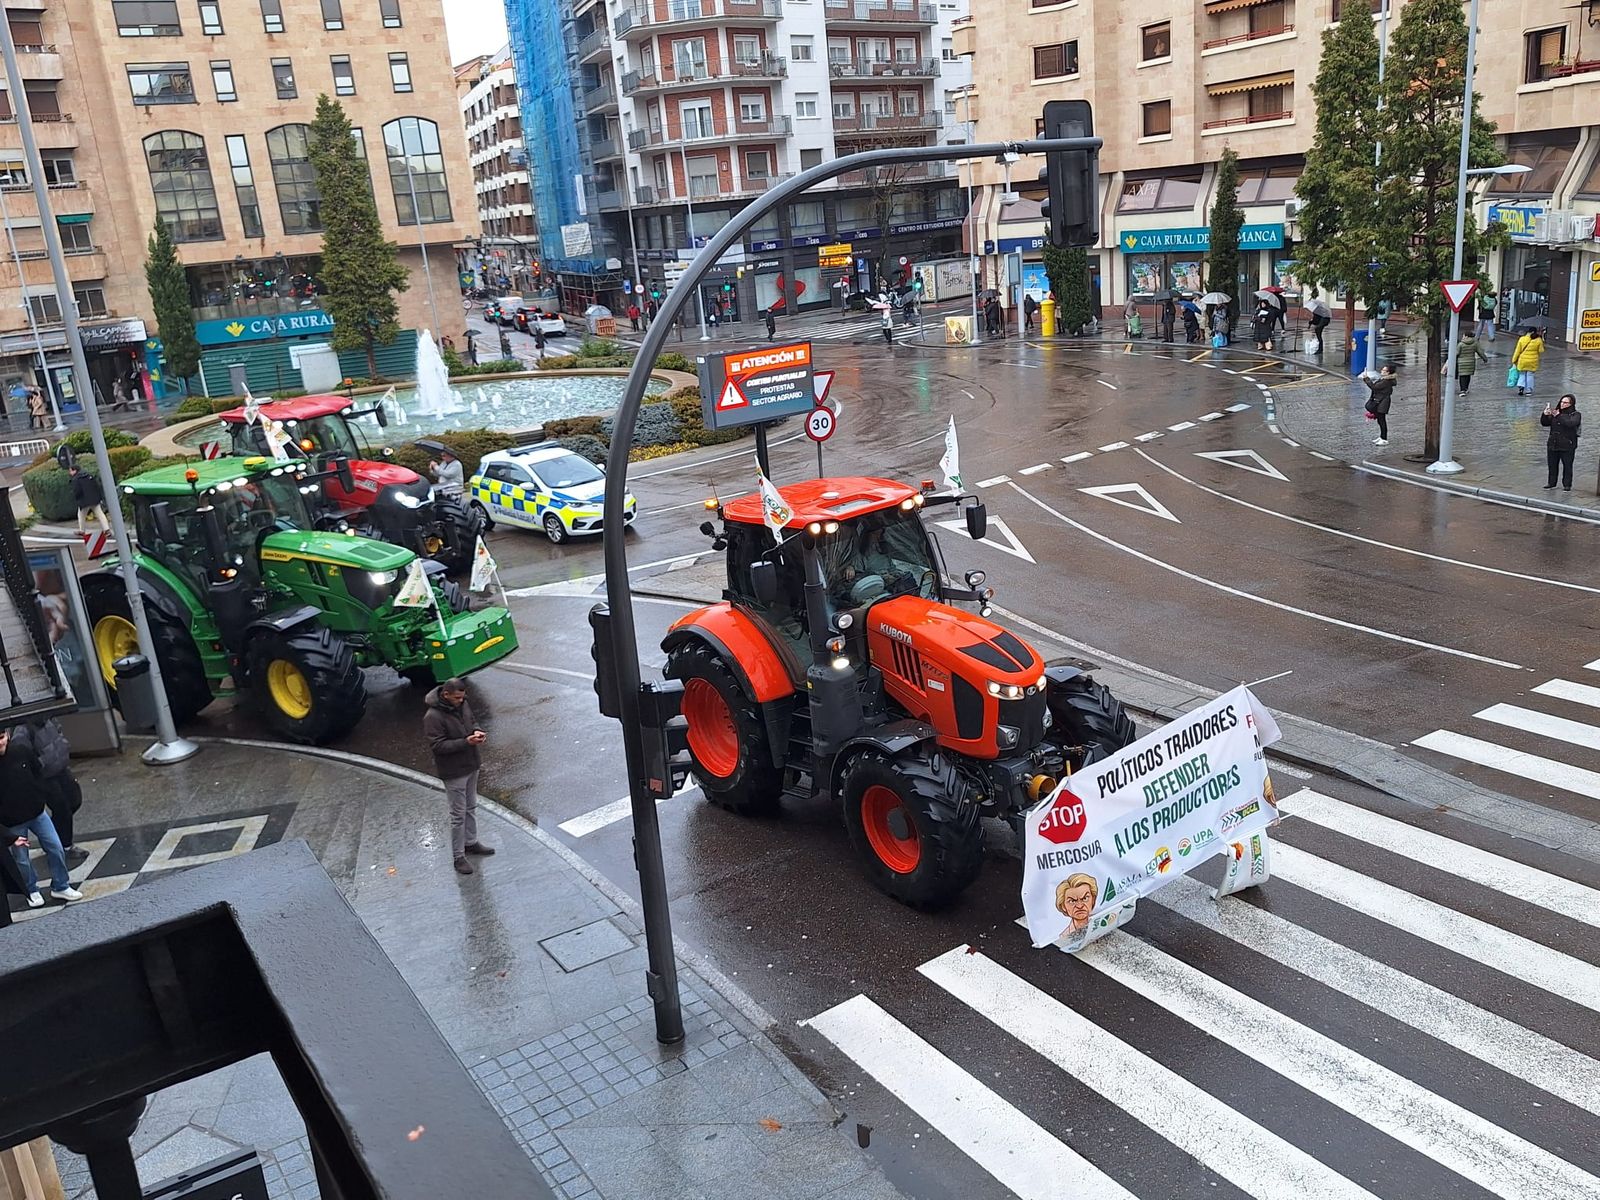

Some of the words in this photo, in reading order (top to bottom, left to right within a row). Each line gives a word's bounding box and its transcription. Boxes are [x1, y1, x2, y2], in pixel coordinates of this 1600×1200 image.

[898, 225, 915, 233] CENTRO
[1141, 235, 1162, 248] CAJA
[1164, 234, 1194, 246] RURAL
[1197, 233, 1209, 244] DE
[1236, 229, 1277, 243] MANCA
[250, 318, 287, 334] CAJA
[742, 351, 795, 369] ATENCIÓN
[760, 382, 795, 394] PROTESTAS
[751, 394, 777, 406] SECTOR
[776, 391, 803, 403] AGRARIO
[812, 417, 829, 430] 30
[879, 622, 913, 645] KUBOTA
[1096, 743, 1164, 799] POLÍTICOS
[1164, 705, 1238, 760] TRAIDORES
[1143, 753, 1211, 808] DEFENDER
[1040, 803, 1084, 831] STOP
[1114, 833, 1126, 858] A
[1124, 816, 1150, 850] LOS
[1152, 764, 1241, 834] PRODUCTORES
[1193, 828, 1214, 844] UPA
[1036, 839, 1103, 870] MERCOSUR
